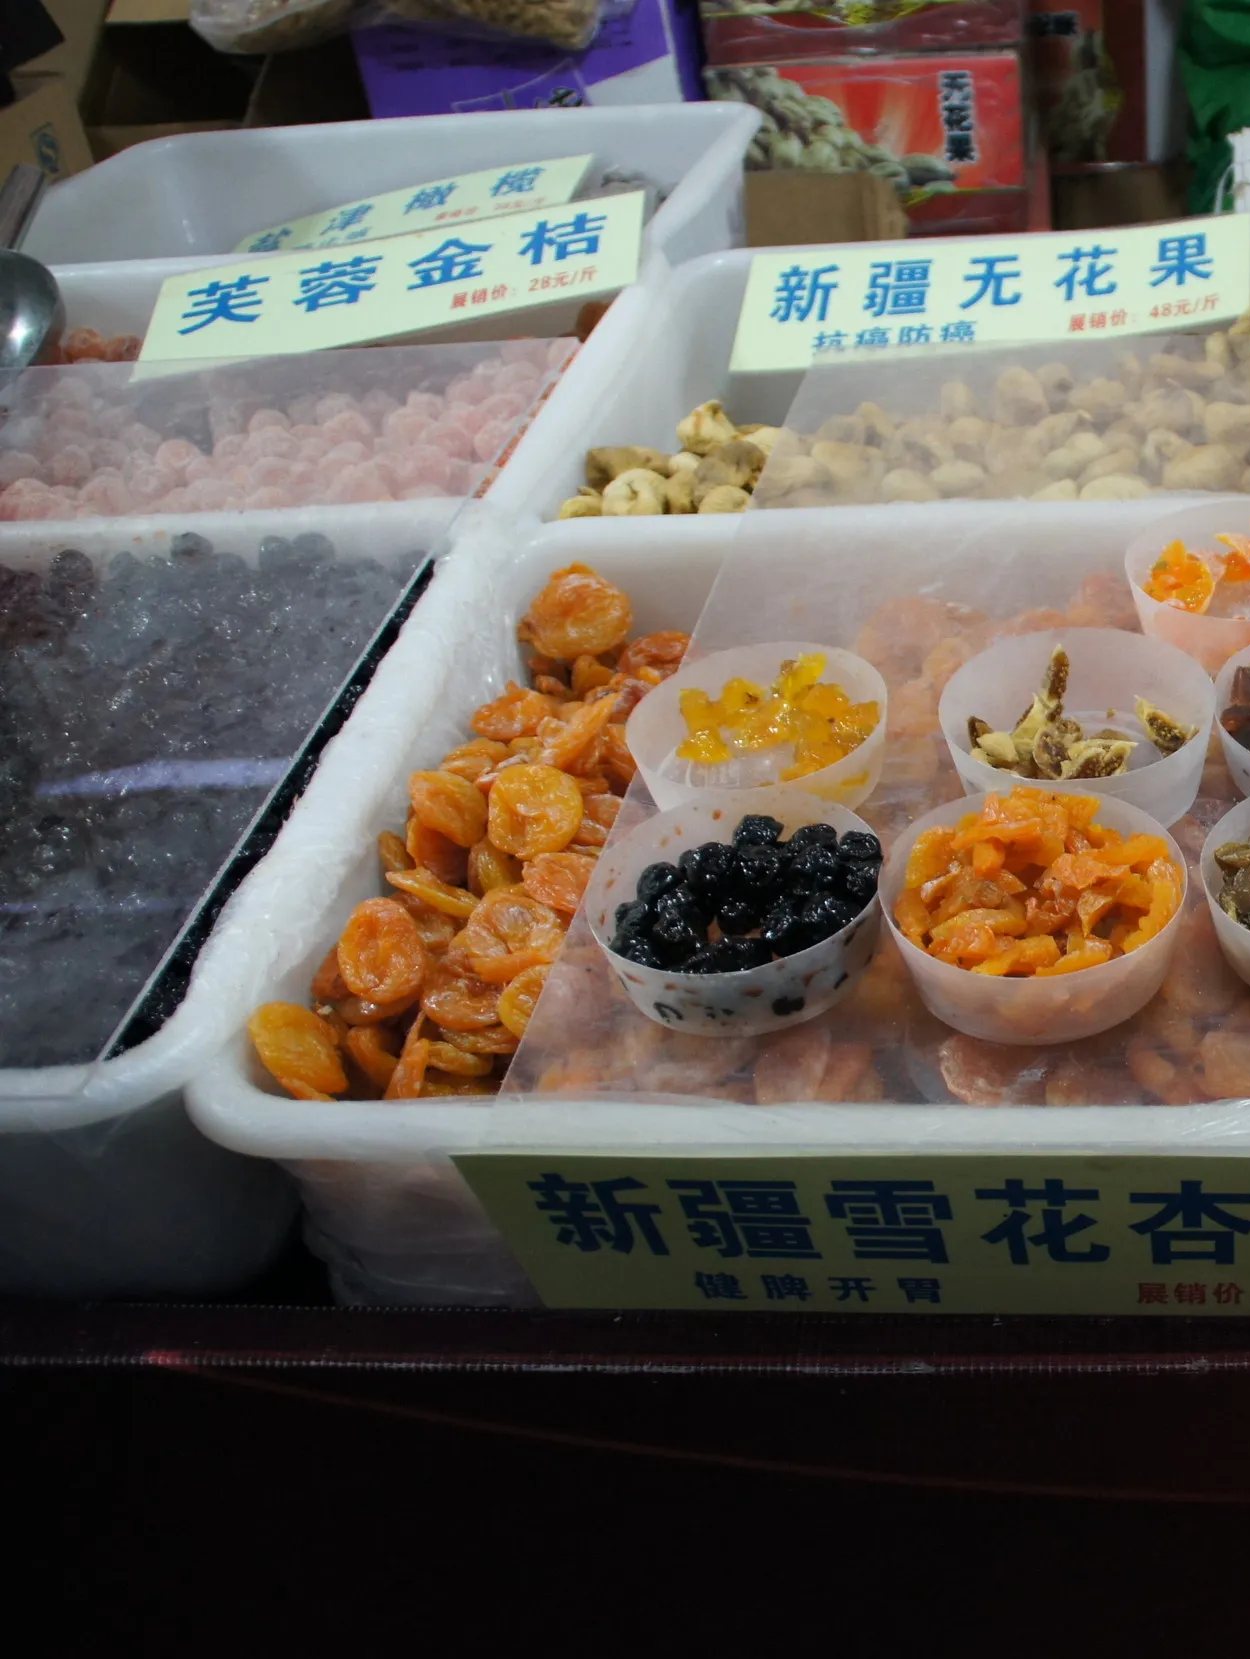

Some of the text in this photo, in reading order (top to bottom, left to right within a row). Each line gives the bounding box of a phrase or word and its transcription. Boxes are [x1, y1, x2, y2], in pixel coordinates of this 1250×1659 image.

[939, 69, 978, 164] 无花果
[177, 211, 608, 336] 芙蓉金桔
[769, 232, 1214, 325] 新疆无花果
[694, 1269, 943, 1304] 健脾开胃
